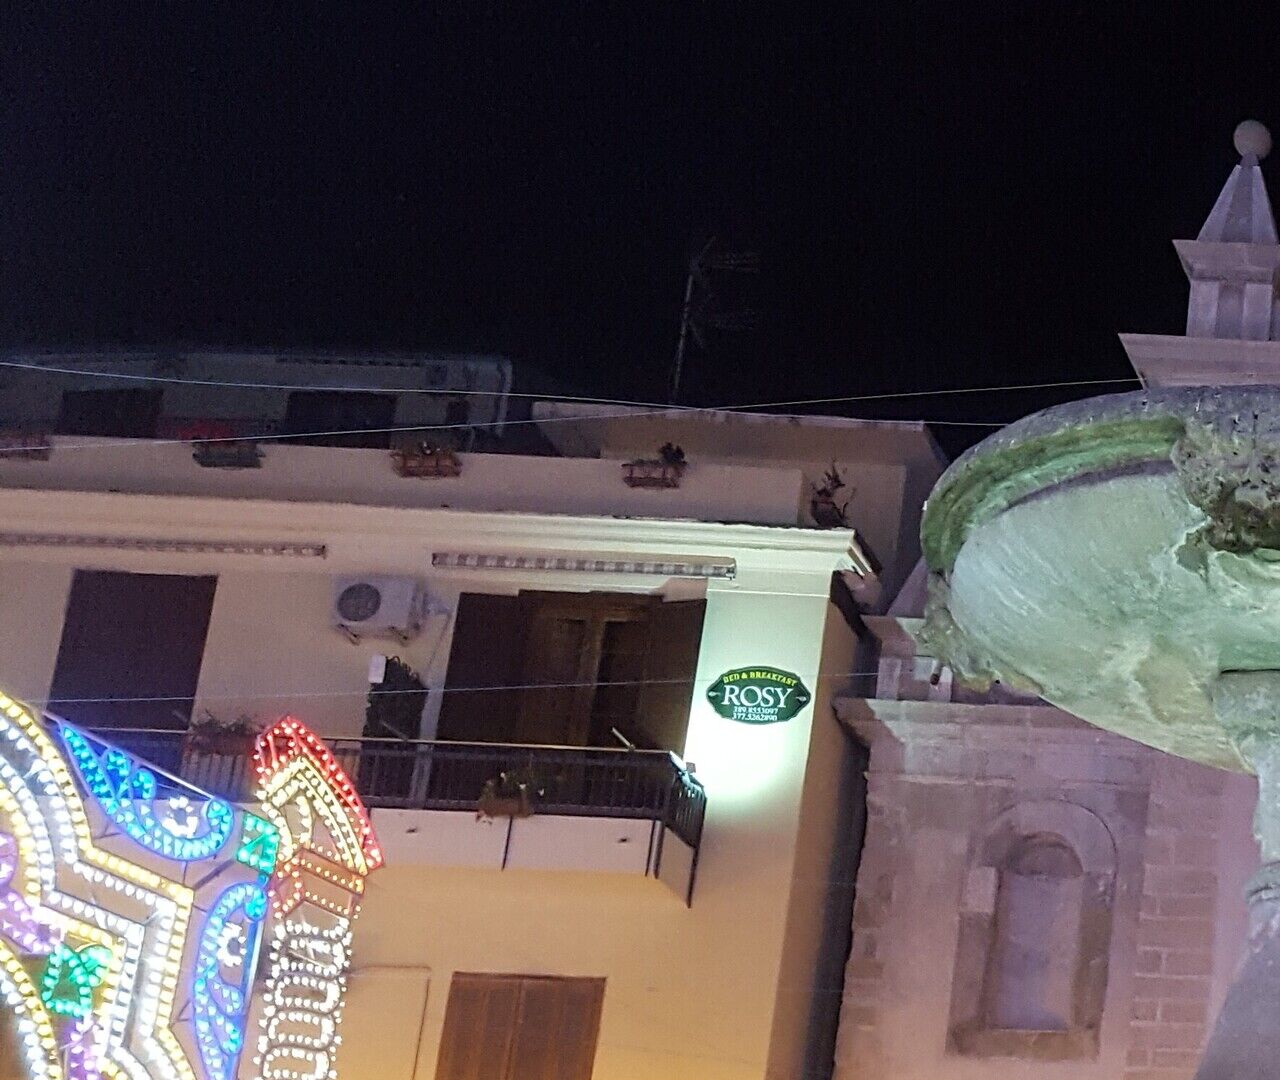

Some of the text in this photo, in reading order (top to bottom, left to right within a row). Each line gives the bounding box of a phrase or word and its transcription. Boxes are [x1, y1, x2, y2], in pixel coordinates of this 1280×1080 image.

[723, 671, 798, 687] BED & BREAKFAST
[720, 684, 794, 708] ROSY
